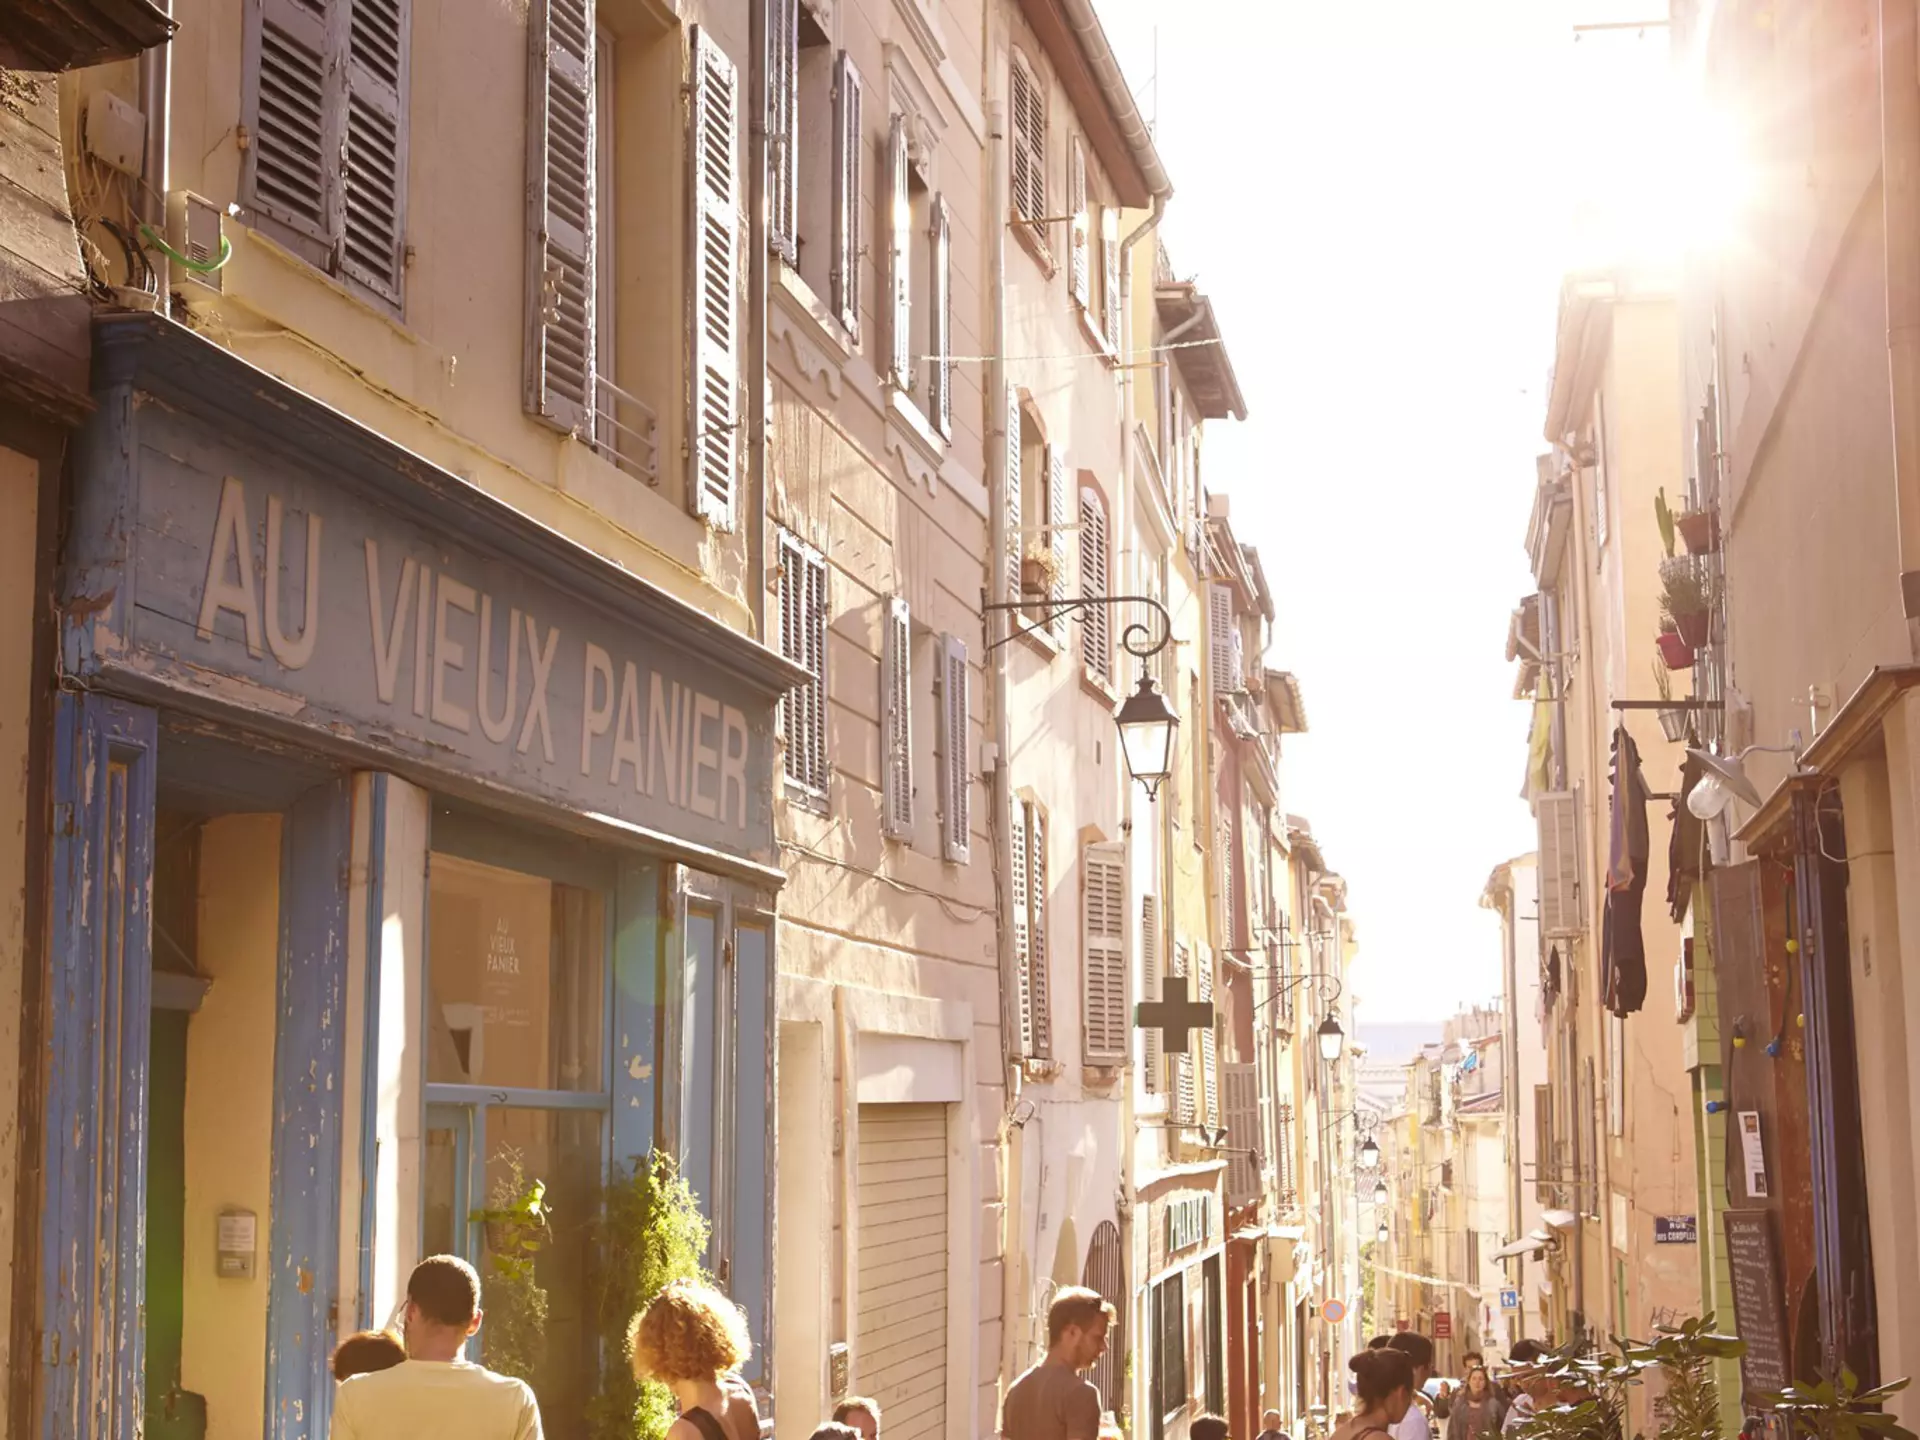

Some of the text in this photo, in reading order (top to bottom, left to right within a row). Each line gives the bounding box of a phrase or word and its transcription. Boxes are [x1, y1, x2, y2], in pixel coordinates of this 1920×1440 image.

[196, 476, 748, 830] AU VIEUX PANIER
[496, 916, 509, 934] AU
[489, 933, 515, 955] VIEUX
[486, 952, 521, 975] PANIER
